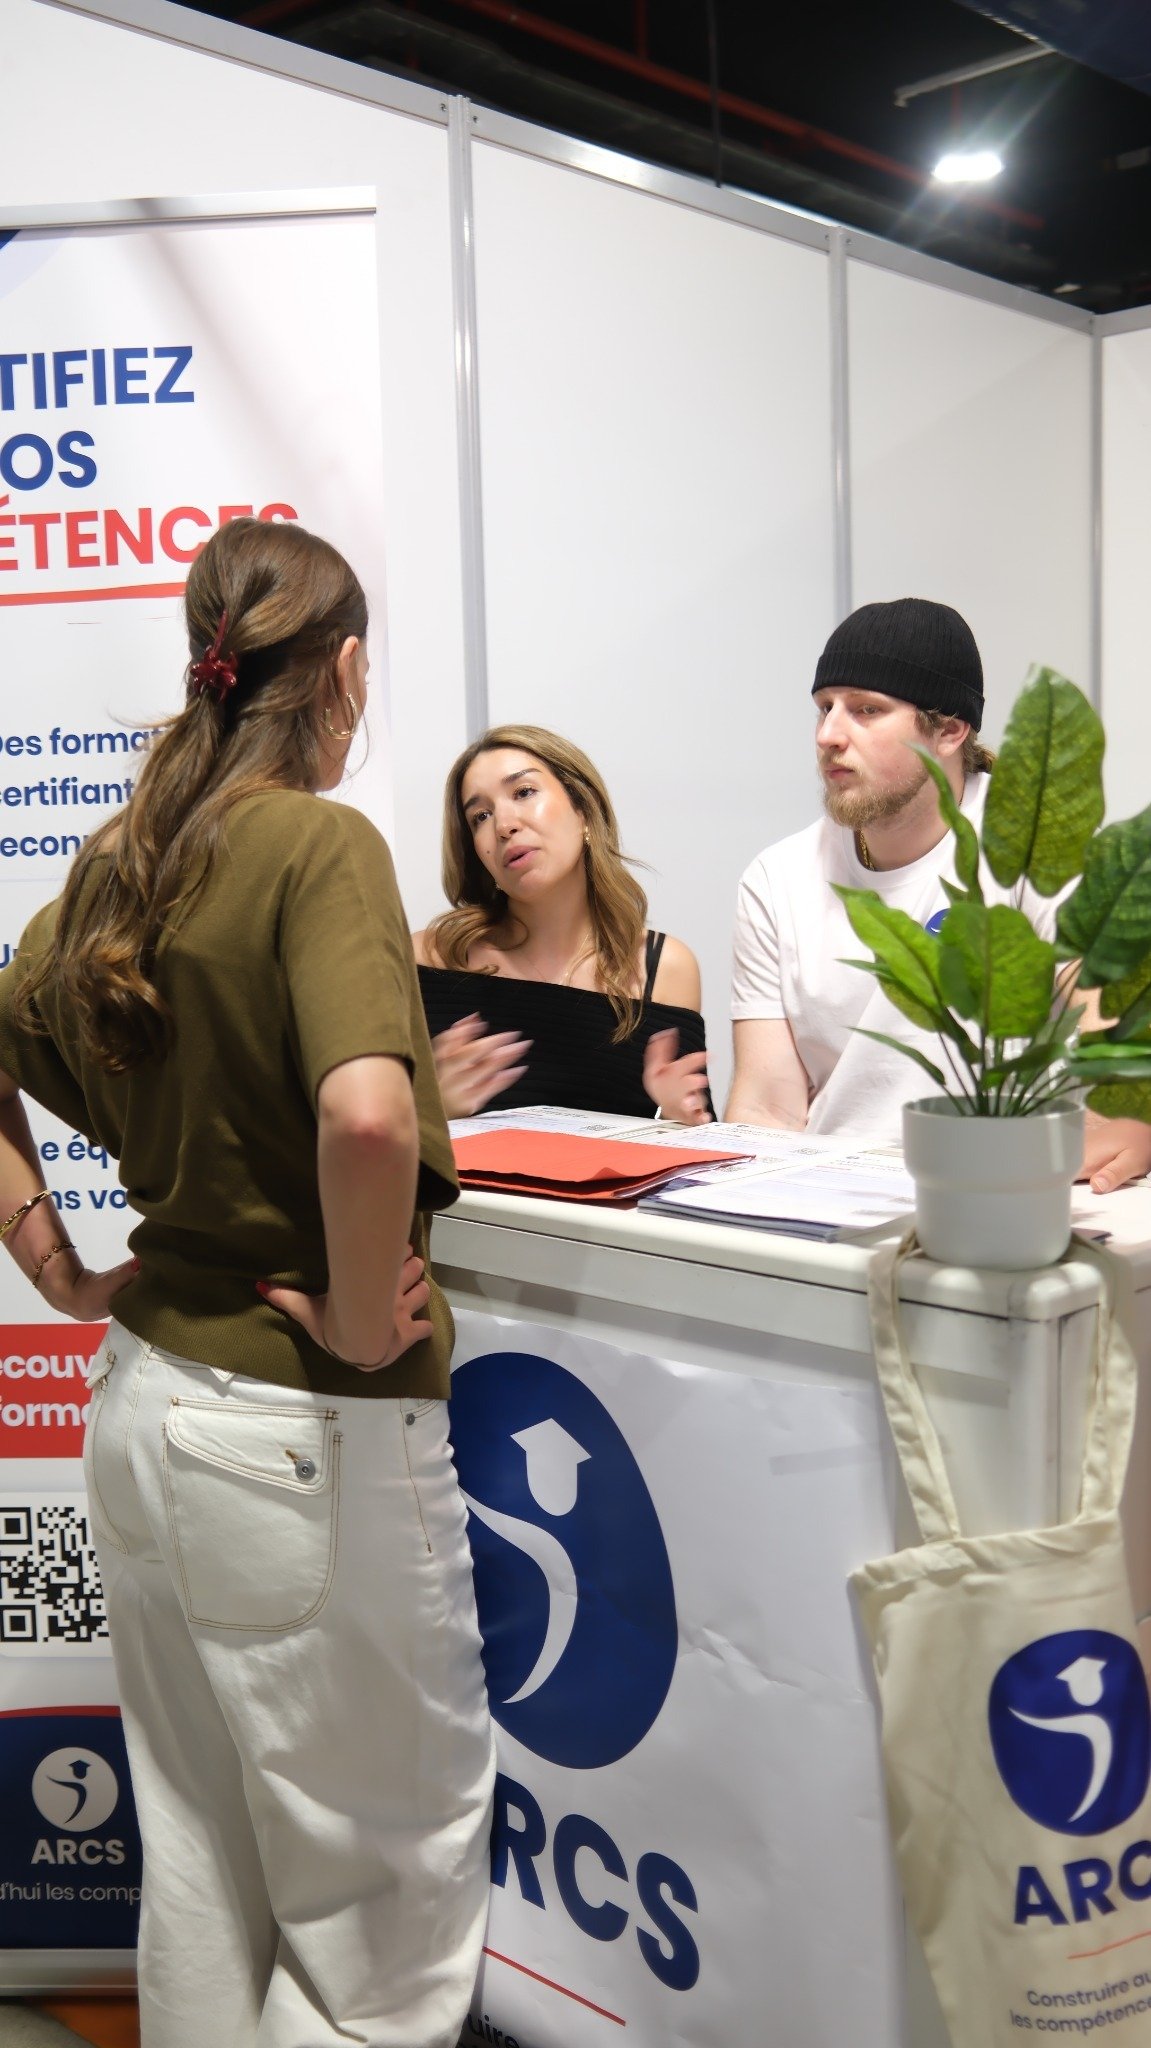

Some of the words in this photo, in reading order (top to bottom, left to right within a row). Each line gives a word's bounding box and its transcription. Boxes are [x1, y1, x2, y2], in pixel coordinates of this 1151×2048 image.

[0, 346, 195, 411] TIFIEZ
[0, 430, 97, 491] OS
[0, 494, 299, 571] ÉTENC
[0, 735, 42, 756] es
[0, 777, 135, 806] ertifiant
[0, 835, 89, 857] econ
[0, 1355, 96, 1379] couv
[0, 1395, 91, 1427] orm
[31, 1839, 126, 1865] ARCS
[46, 1883, 75, 1901] les
[79, 1886, 141, 1906] comp
[490, 1771, 699, 1992] RCS
[1014, 1840, 1151, 1926] ARC
[1027, 1981, 1129, 2008] Construire
[1010, 2009, 1032, 2029] les
